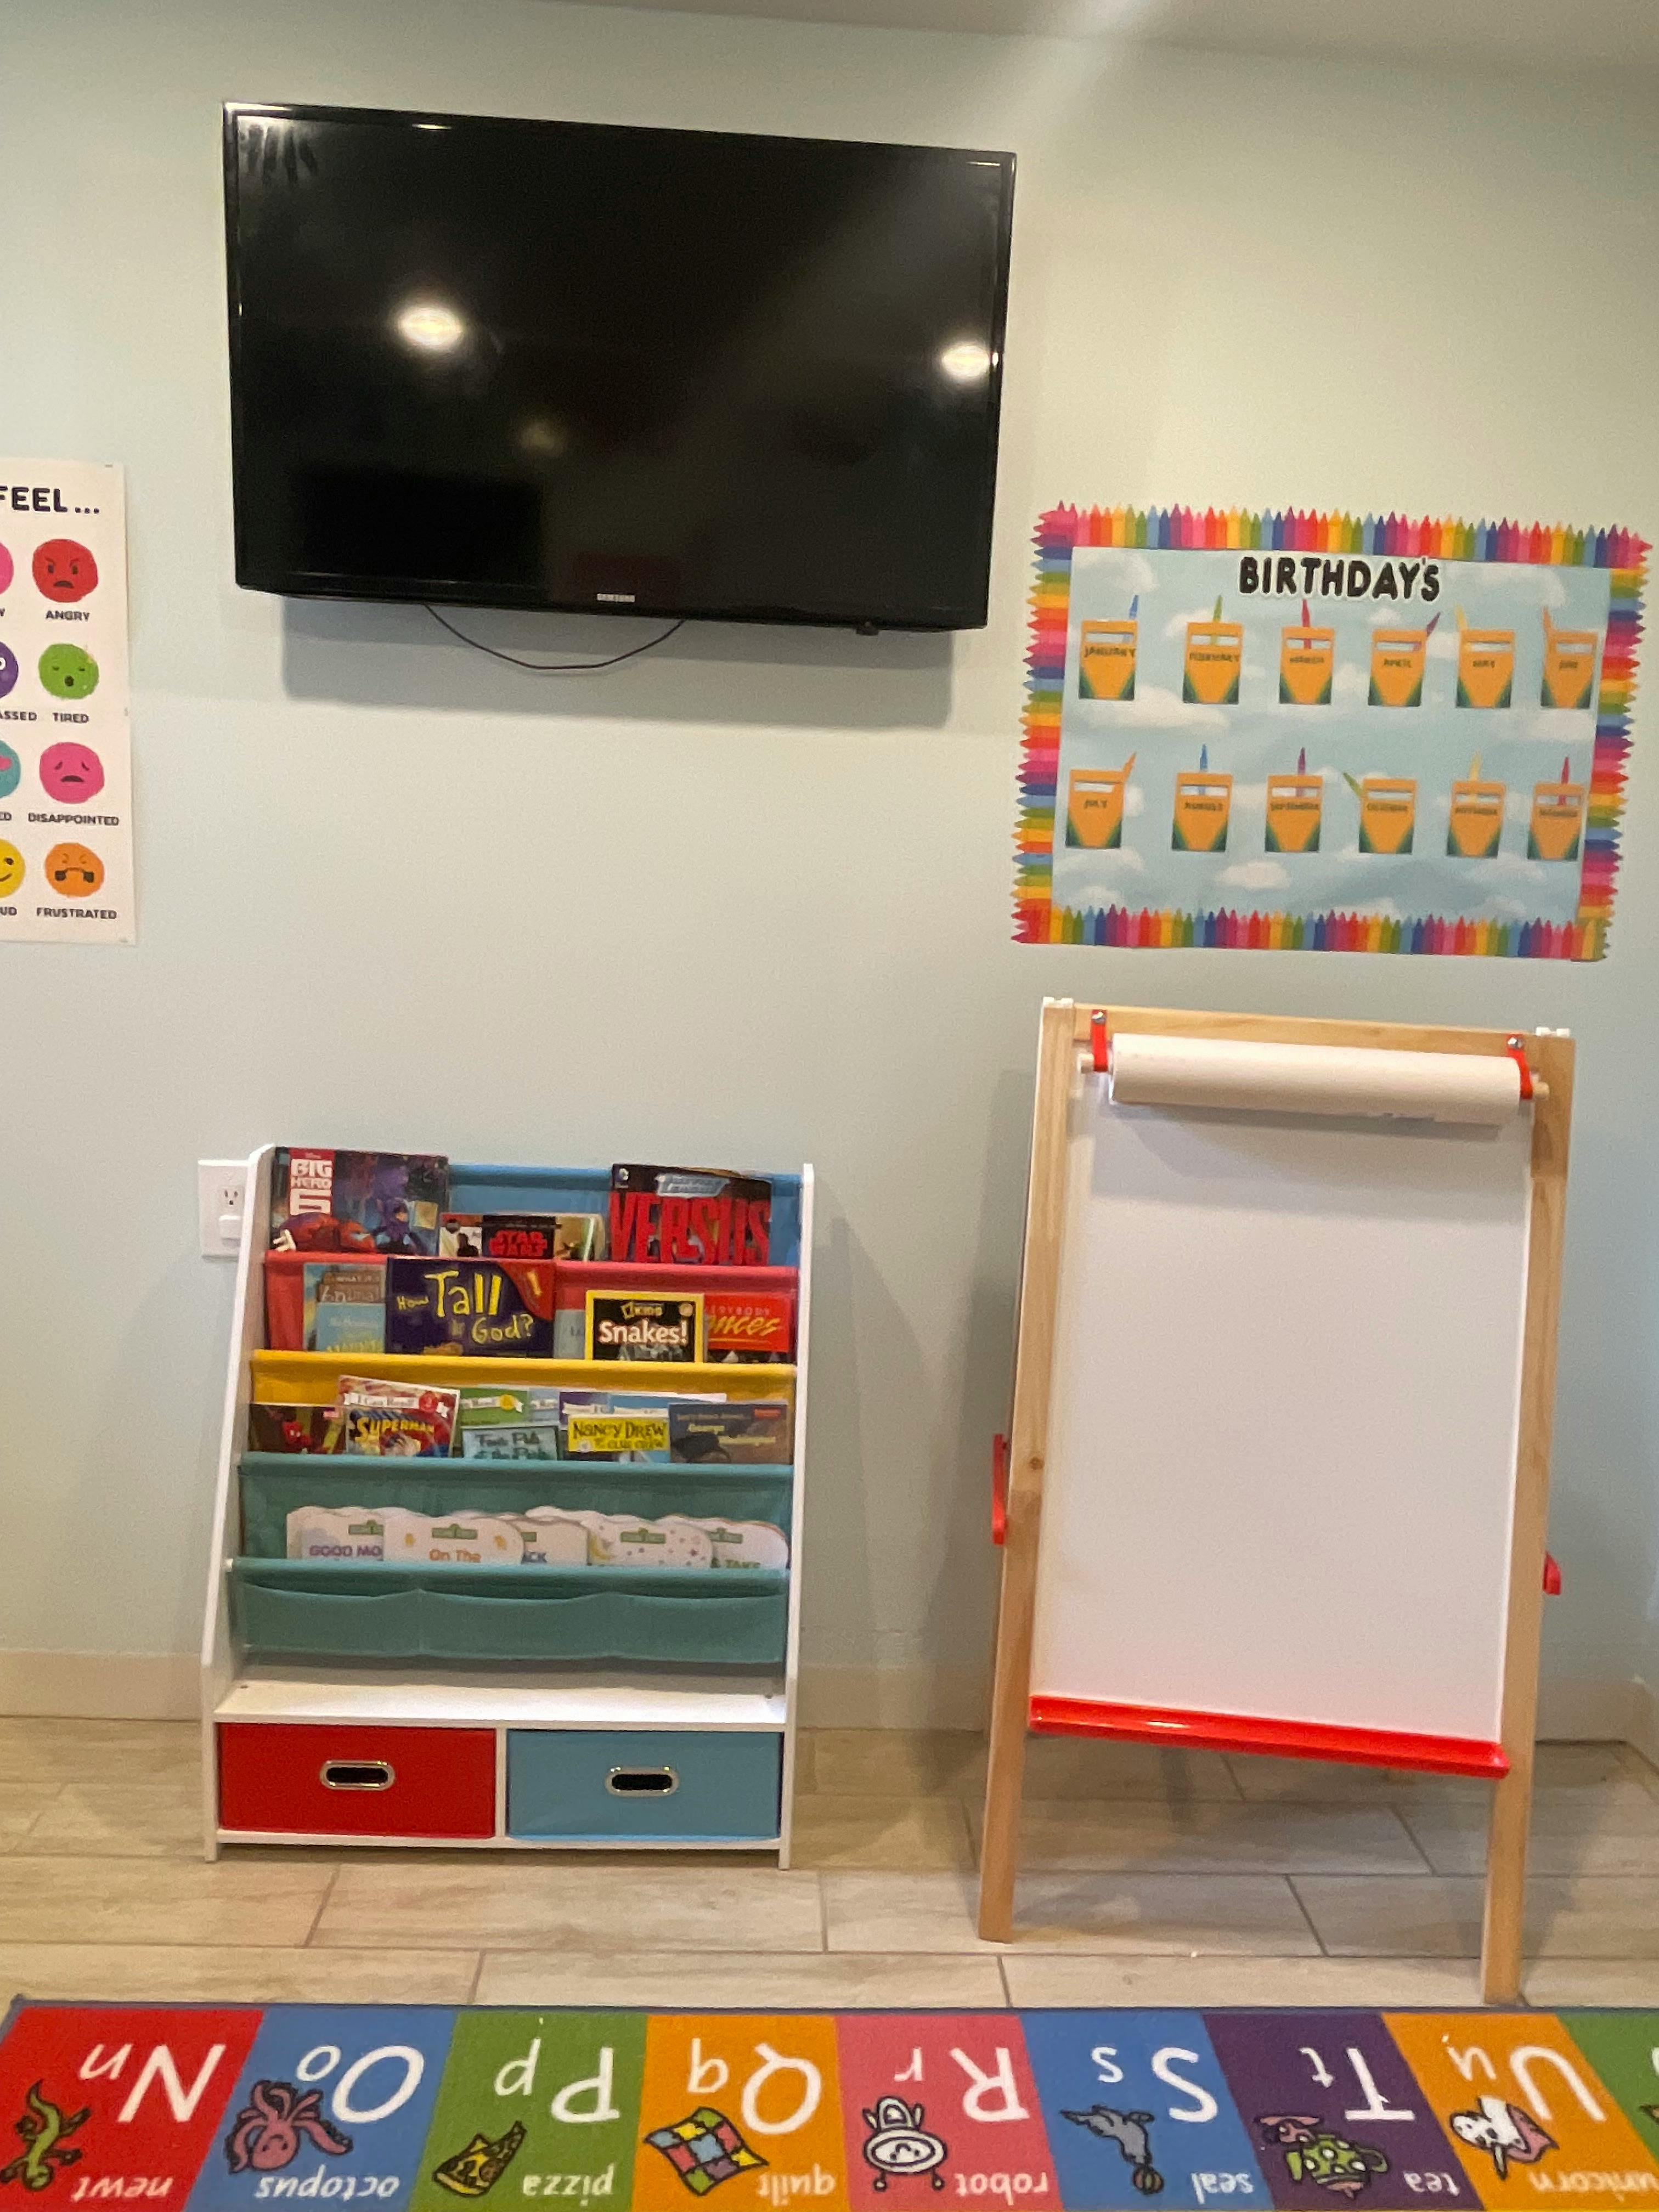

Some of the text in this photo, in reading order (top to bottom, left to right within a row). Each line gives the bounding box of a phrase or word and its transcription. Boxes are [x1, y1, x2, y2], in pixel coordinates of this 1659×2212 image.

[1240, 556, 1440, 602] BIRTHDAY'S
[46, 610, 90, 621] ANGRY
[53, 712, 89, 723] TIRED
[28, 812, 120, 826] DISAPPOINTED
[36, 907, 117, 919] FRUSTRATED
[291, 1159, 332, 1177] BIG
[291, 1176, 332, 1190] HERO
[608, 1191, 771, 1266] VERSUS
[424, 1270, 503, 1318] Tall
[472, 1313, 533, 1344] God?
[599, 1317, 689, 1345] Snakes!
[355, 1417, 435, 1444] SUPERMAN
[625, 1421, 665, 1440] DREW
[309, 1545, 353, 1557] GOOD
[429, 1548, 450, 1562] On
[70, 2176, 173, 2203] newt
[254, 2164, 401, 2200] octopus
[522, 2162, 616, 2207] pizza
[756, 2163, 838, 2207] quilt
[955, 2172, 1049, 2206] robot
[1190, 2171, 1255, 2205] seal
[1403, 2171, 1461, 2197] tea
